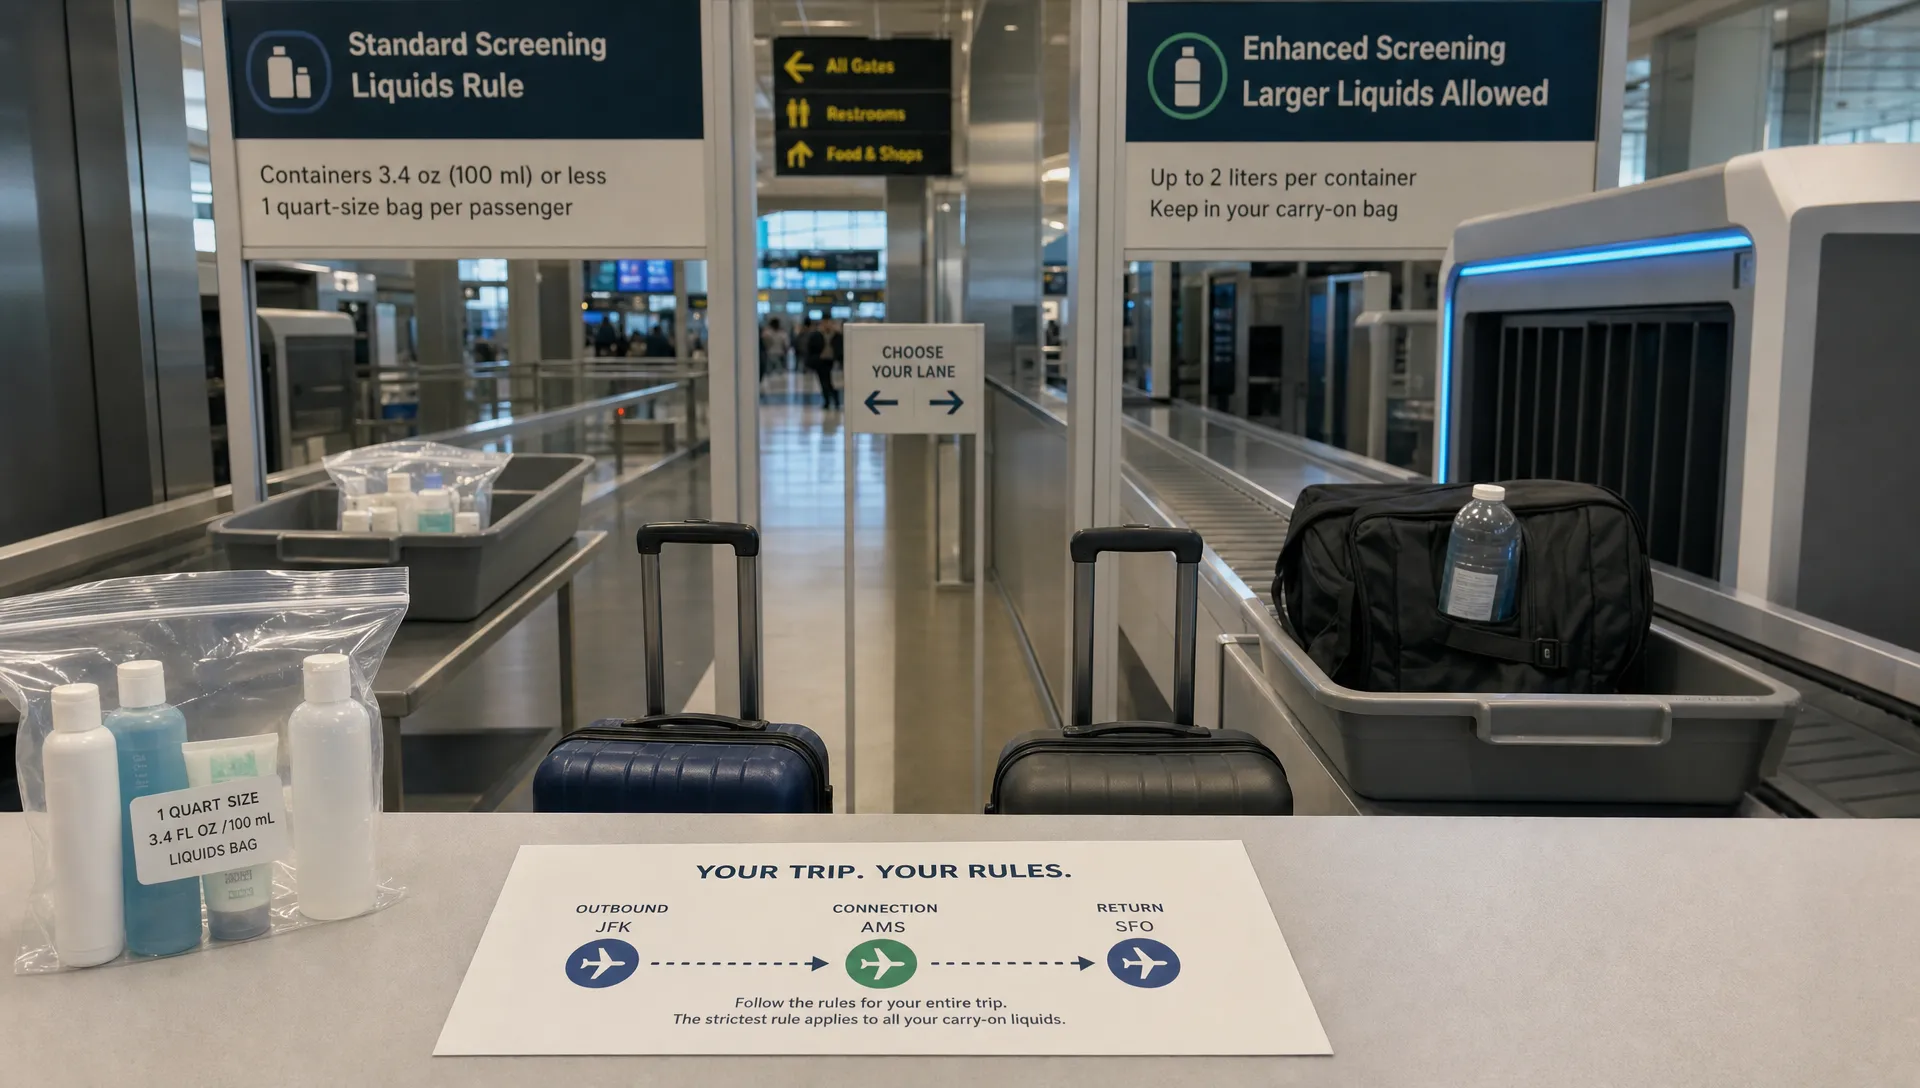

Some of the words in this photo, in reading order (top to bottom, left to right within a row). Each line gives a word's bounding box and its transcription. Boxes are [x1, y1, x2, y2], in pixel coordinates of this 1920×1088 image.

[349, 31, 467, 56] Standard
[476, 32, 606, 61] Screening
[1244, 35, 1368, 60] Enhanced
[1377, 35, 1505, 65] Screening
[826, 58, 847, 73] All
[851, 58, 894, 73] Gates
[352, 72, 453, 104] Liquids
[463, 72, 524, 98] Rule
[1244, 80, 1330, 112] Larger
[1338, 79, 1433, 112] Liquids
[1441, 79, 1548, 106] Allowed
[827, 106, 905, 121] Restrooms
[827, 146, 862, 161] Food
[865, 146, 876, 161] &
[880, 145, 923, 163] Shops
[261, 165, 372, 184] Containers
[380, 165, 410, 184] 3.4
[418, 171, 440, 184] oz
[450, 165, 492, 187] (100
[501, 165, 532, 187] ml)
[541, 171, 561, 184] or
[569, 166, 606, 184] less
[1152, 169, 1177, 190] Up
[1185, 170, 1203, 186] to
[1211, 168, 1221, 186] 2
[1230, 168, 1277, 186] liters
[1286, 173, 1317, 191] per
[1325, 168, 1416, 186] container
[262, 197, 269, 215] 1
[277, 197, 379, 219] quart-size
[387, 197, 422, 220] bag
[431, 202, 462, 220] per
[470, 202, 573, 220] passenger
[1151, 200, 1198, 222] Keep
[1205, 200, 1219, 217] in
[1227, 204, 1269, 222] your
[1276, 204, 1356, 221] carry-on
[1364, 200, 1397, 221] bag
[883, 346, 943, 359] CHOOSE
[872, 365, 912, 378] YOUR
[918, 366, 955, 378] LANE
[158, 809, 163, 820] 1
[170, 798, 220, 818] QUART
[228, 792, 259, 807] SIZE
[149, 831, 172, 845] 3.4
[177, 828, 193, 840] FL
[198, 823, 217, 836] OZ
[256, 812, 275, 826] mL
[170, 845, 225, 865] LIQUIDS
[230, 839, 257, 854] BAG
[697, 865, 778, 879] YOUR
[790, 865, 863, 879] TRIP.
[876, 865, 958, 878] YOUR
[969, 864, 1071, 878] RULES.
[576, 905, 668, 913] OUTBOUND
[833, 904, 937, 913] CONNECTION
[1097, 904, 1163, 912] RETURN
[596, 922, 631, 932] JFK
[861, 922, 905, 932] AMS
[1116, 921, 1153, 932] SFO
[736, 997, 784, 1008] Follow
[789, 997, 813, 1008] the
[819, 997, 855, 1008] rules
[861, 997, 882, 1008] for
[887, 1000, 921, 1011] your
[926, 998, 971, 1008] entire
[976, 998, 1006, 1011] trip.
[674, 1014, 700, 1024] The
[706, 1014, 767, 1024] strictest
[772, 1014, 800, 1024] rule
[805, 1014, 858, 1027] applies
[863, 1015, 878, 1024] to
[883, 1014, 899, 1024] all
[904, 1017, 938, 1027] your
[943, 1017, 1006, 1027] carry-on
[1012, 1014, 1065, 1027] liquids.
